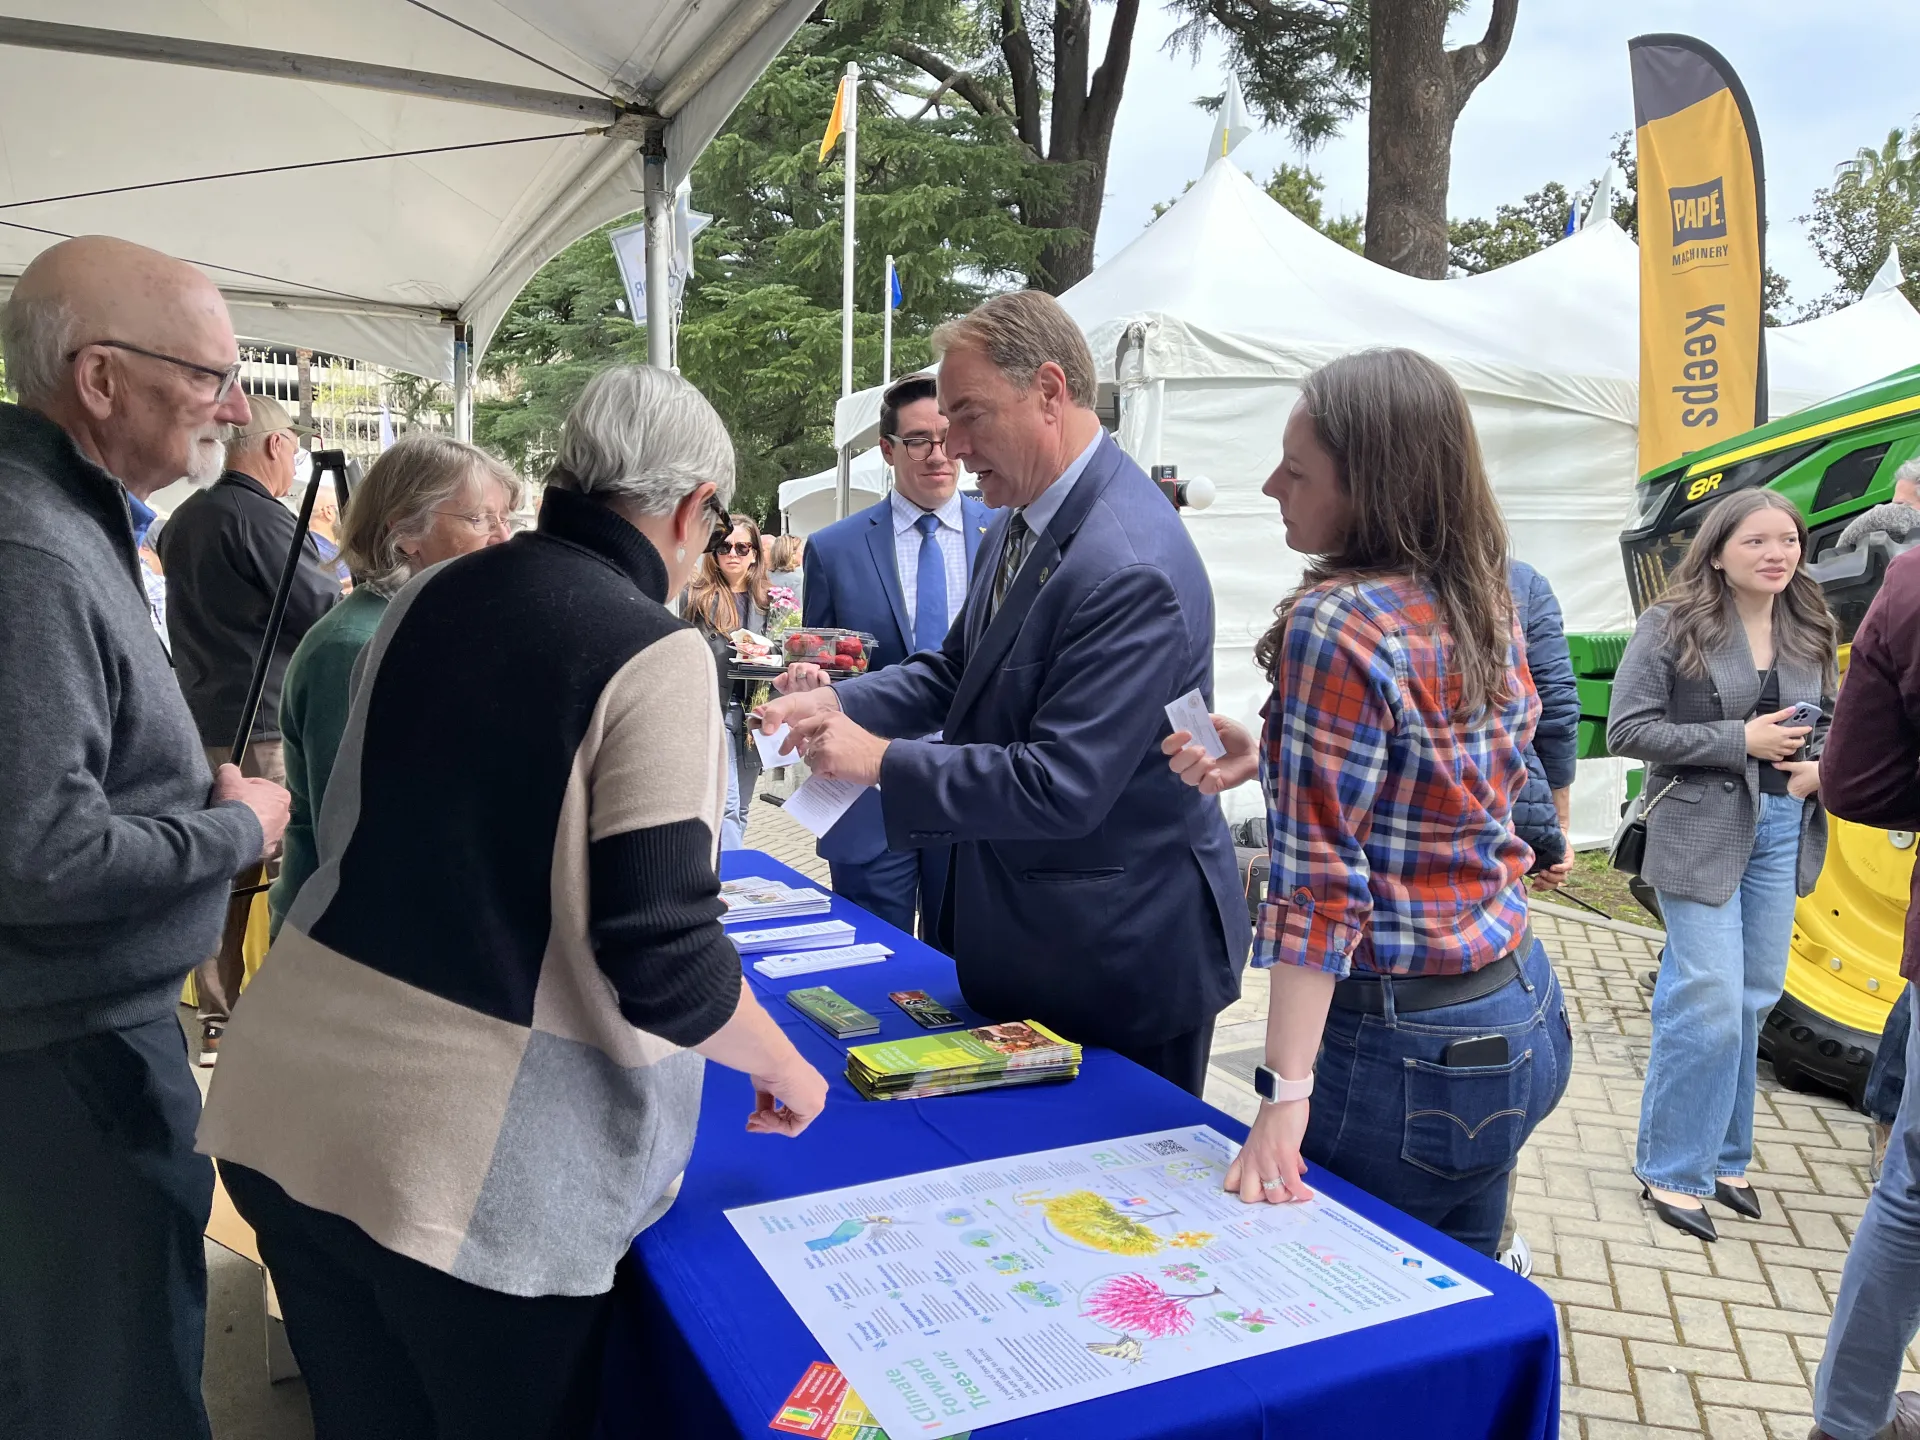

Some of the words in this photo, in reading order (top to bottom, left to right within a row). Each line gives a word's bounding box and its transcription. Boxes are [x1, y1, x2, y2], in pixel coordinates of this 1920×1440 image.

[1673, 189, 1720, 232] PAPÉ
[1672, 244, 1728, 266] MACHINERY
[1672, 304, 1726, 428] Keeps
[1686, 472, 1723, 501] 8R
[1087, 1151, 1124, 1168] 29
[1288, 1258, 1307, 1267] the
[1293, 1252, 1345, 1283] inexpensive
[1310, 1272, 1335, 1286] trees
[1328, 1265, 1362, 1284] system
[1330, 1286, 1372, 1310] Planting
[1355, 1284, 1391, 1304] natural
[1366, 1281, 1402, 1302] climate
[930, 1349, 960, 1370] are
[962, 1347, 985, 1365] species
[974, 1347, 994, 1362] thrive
[978, 1364, 991, 1374] tree
[991, 1366, 1013, 1381] likely
[901, 1357, 967, 1417] Forward
[945, 1371, 994, 1409] Trees
[990, 1379, 1014, 1396] palette
[1006, 1379, 1018, 1387] are
[1019, 1380, 1034, 1389] the
[878, 1367, 939, 1424] Climate
[1012, 1388, 1028, 1398] that
